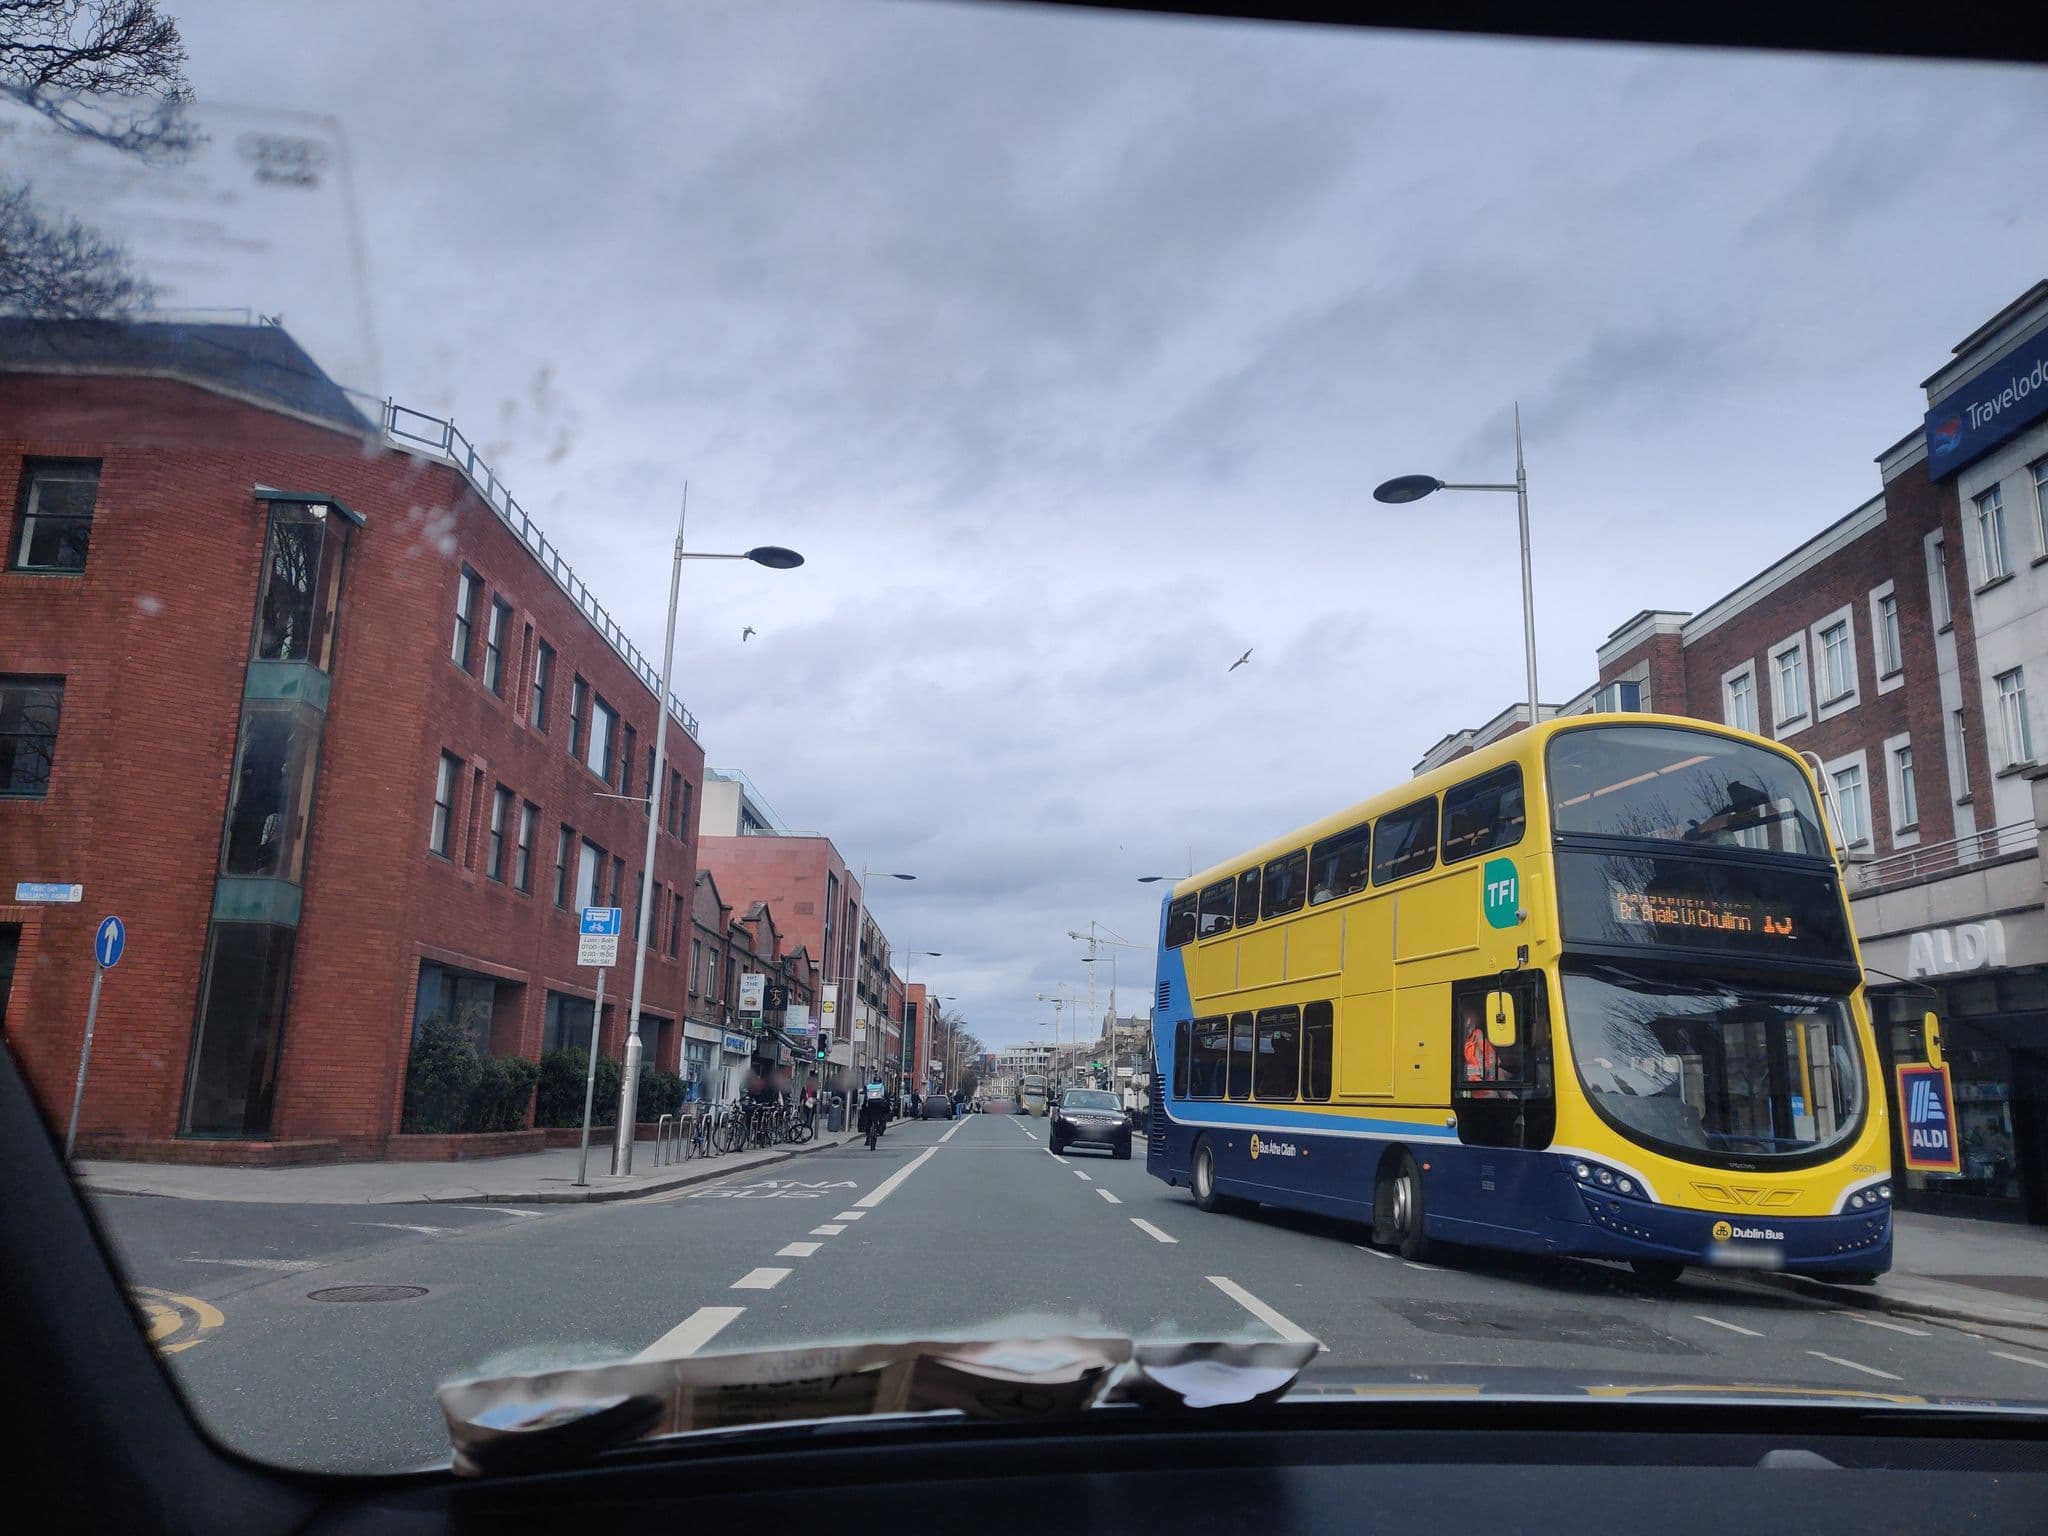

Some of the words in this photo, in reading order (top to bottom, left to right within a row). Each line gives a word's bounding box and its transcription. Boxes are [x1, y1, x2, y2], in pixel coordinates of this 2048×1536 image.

[1487, 877, 1515, 908] TFI
[1907, 918, 2008, 979] ALDI
[1260, 1141, 1269, 1154] Bus
[1912, 1129, 1948, 1149] ALDI
[1733, 1227, 1764, 1239] Dublin
[1765, 1229, 1785, 1240] Bus
